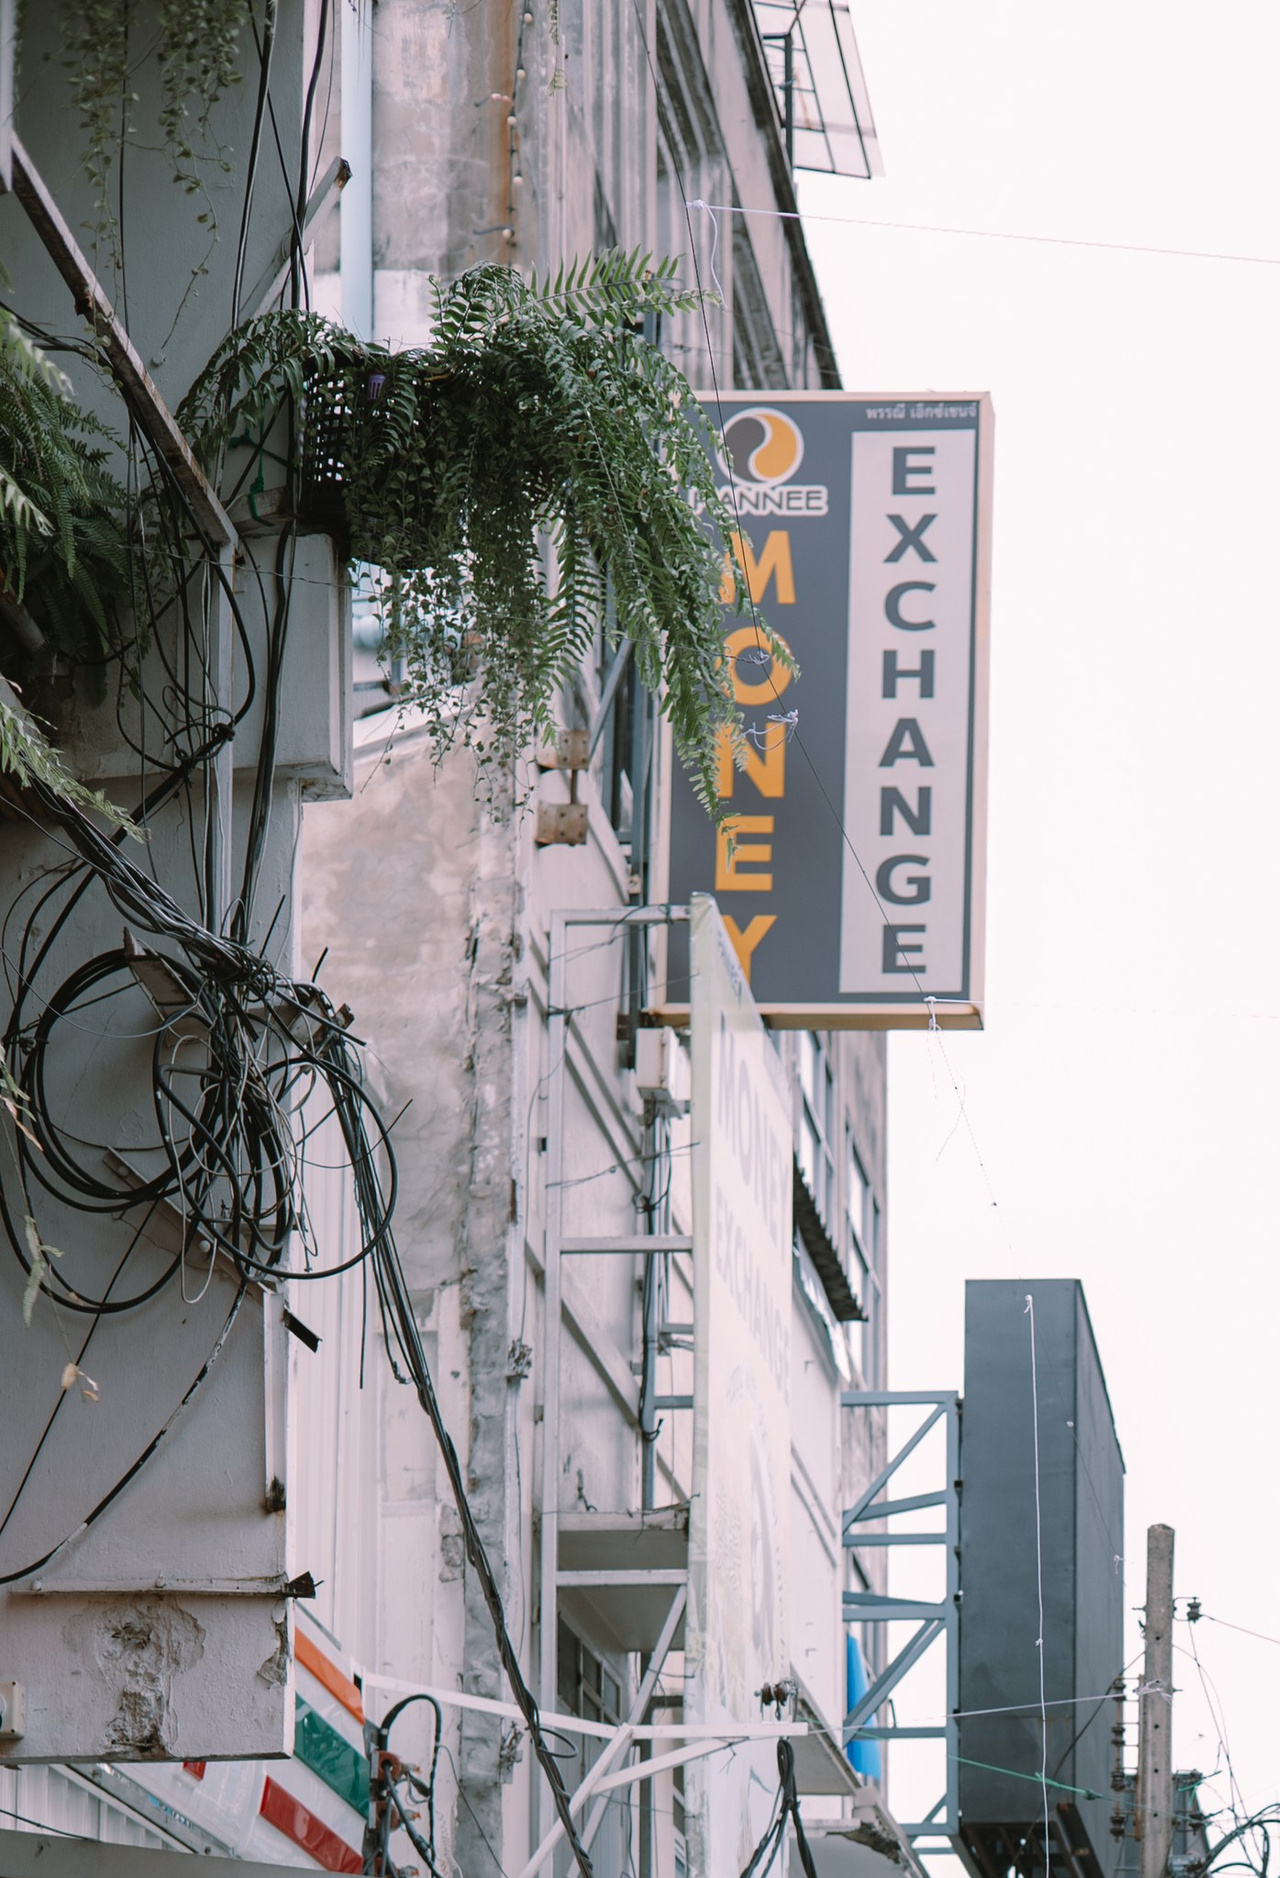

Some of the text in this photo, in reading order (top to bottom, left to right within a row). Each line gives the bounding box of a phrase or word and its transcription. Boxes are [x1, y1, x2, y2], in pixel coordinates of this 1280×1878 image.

[715, 530, 797, 988] MONEY
[875, 446, 938, 975] EXCHANGE
[717, 1010, 789, 1270] MONEY
